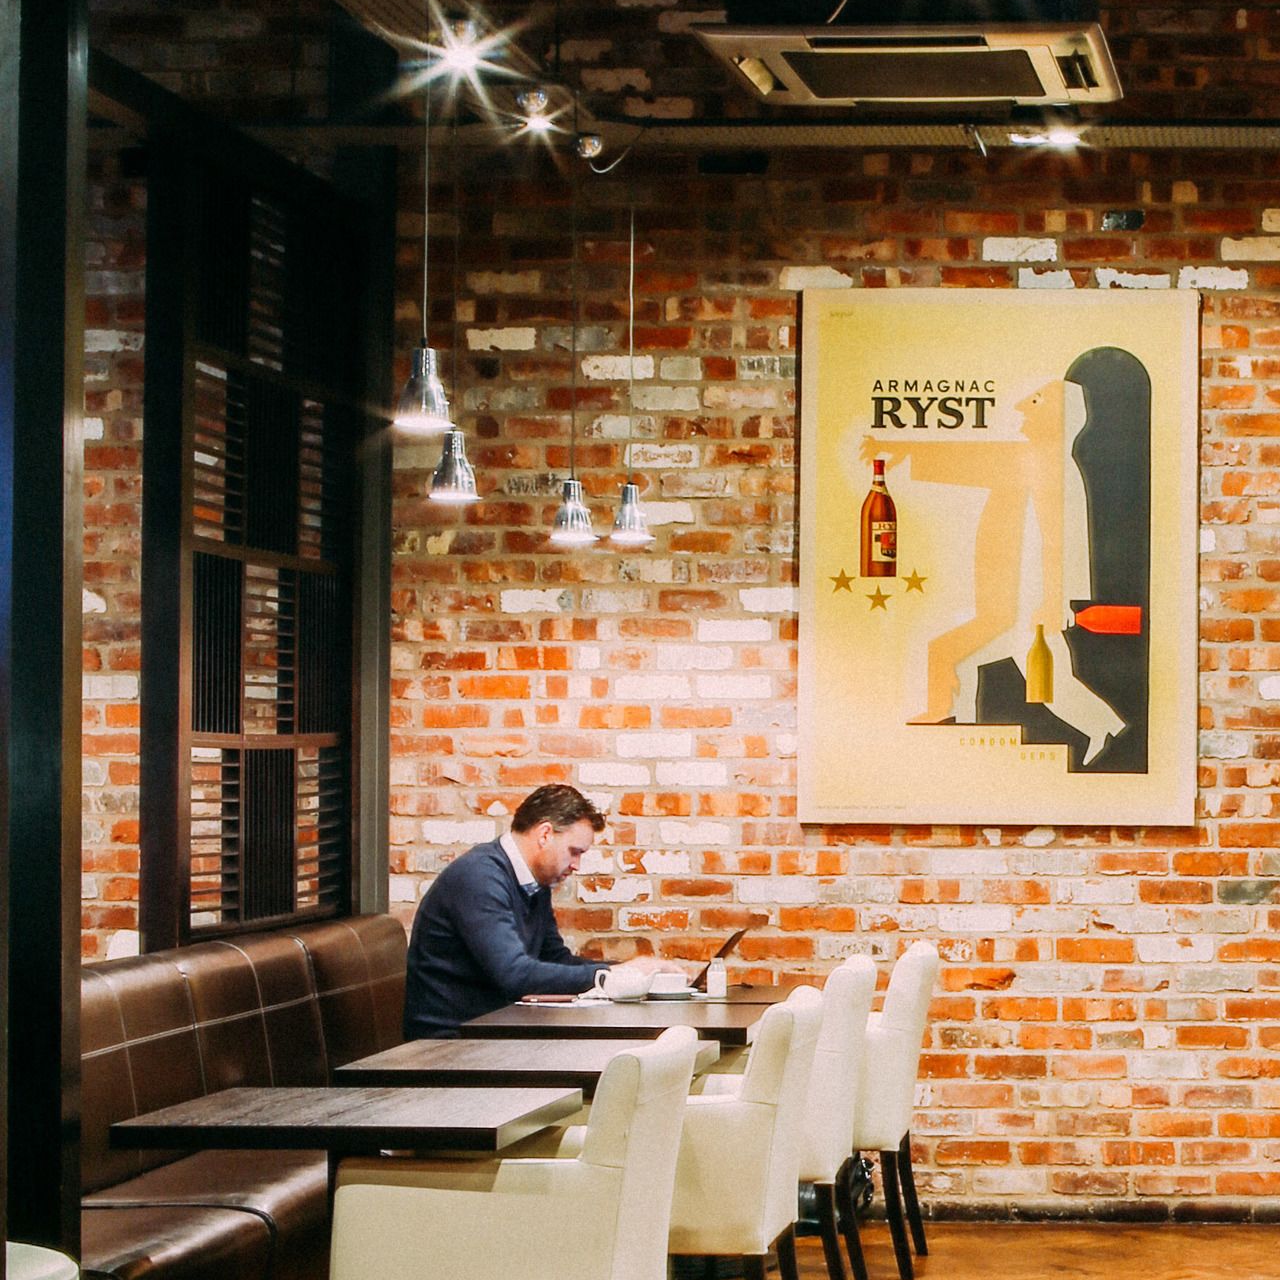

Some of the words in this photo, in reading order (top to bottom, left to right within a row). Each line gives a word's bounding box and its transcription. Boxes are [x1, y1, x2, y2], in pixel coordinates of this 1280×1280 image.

[872, 379, 995, 393] ARMAGNAC
[870, 396, 996, 429] RYST
[959, 737, 1018, 747] CONDOM
